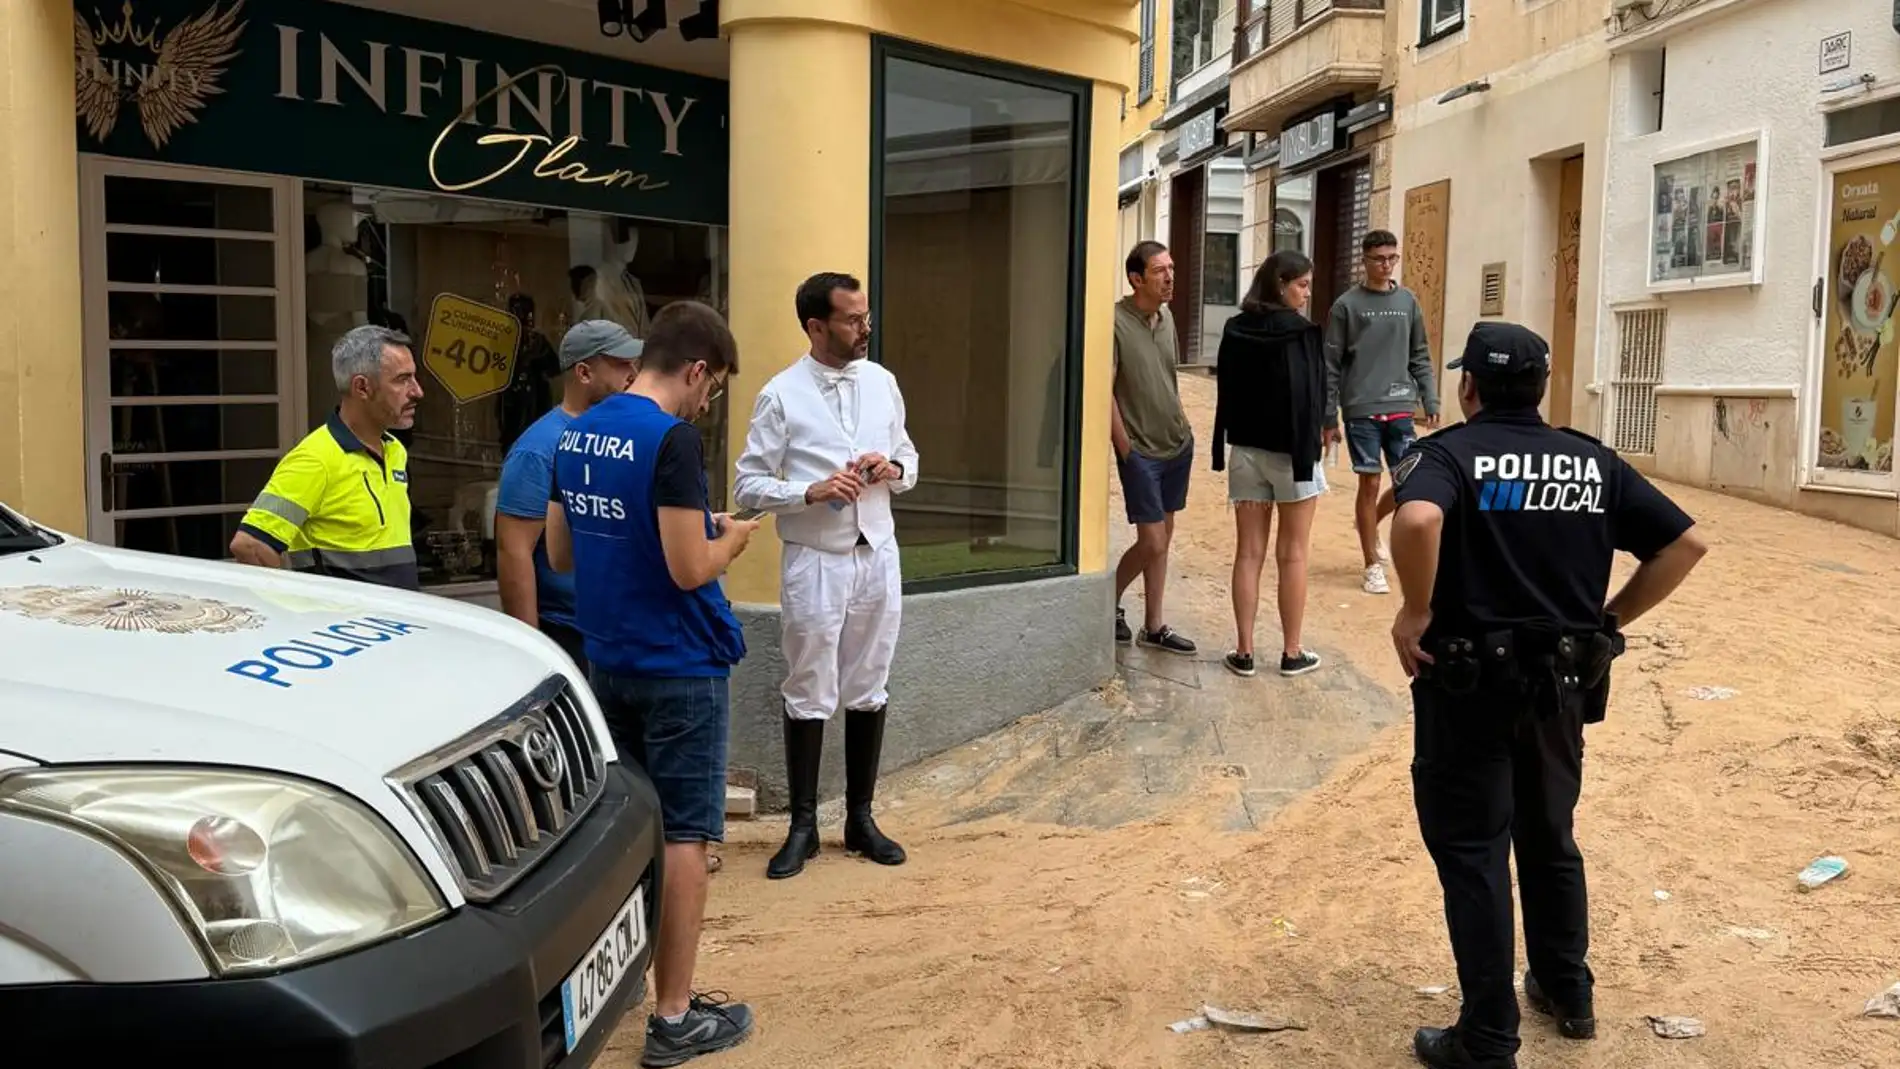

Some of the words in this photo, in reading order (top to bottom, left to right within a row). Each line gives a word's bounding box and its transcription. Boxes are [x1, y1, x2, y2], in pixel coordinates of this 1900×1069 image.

[273, 23, 699, 157] INFINITY
[428, 64, 669, 191] Glam
[1842, 205, 1877, 223] Natural
[440, 310, 452, 326] 2
[431, 338, 508, 376] -40%
[559, 430, 635, 461] CULTURA
[584, 463, 591, 486] I
[1474, 453, 1603, 484] POLICIA
[1523, 482, 1606, 514] LOCAL
[225, 617, 428, 688] POLICIA
[578, 938, 614, 1021] 4786
